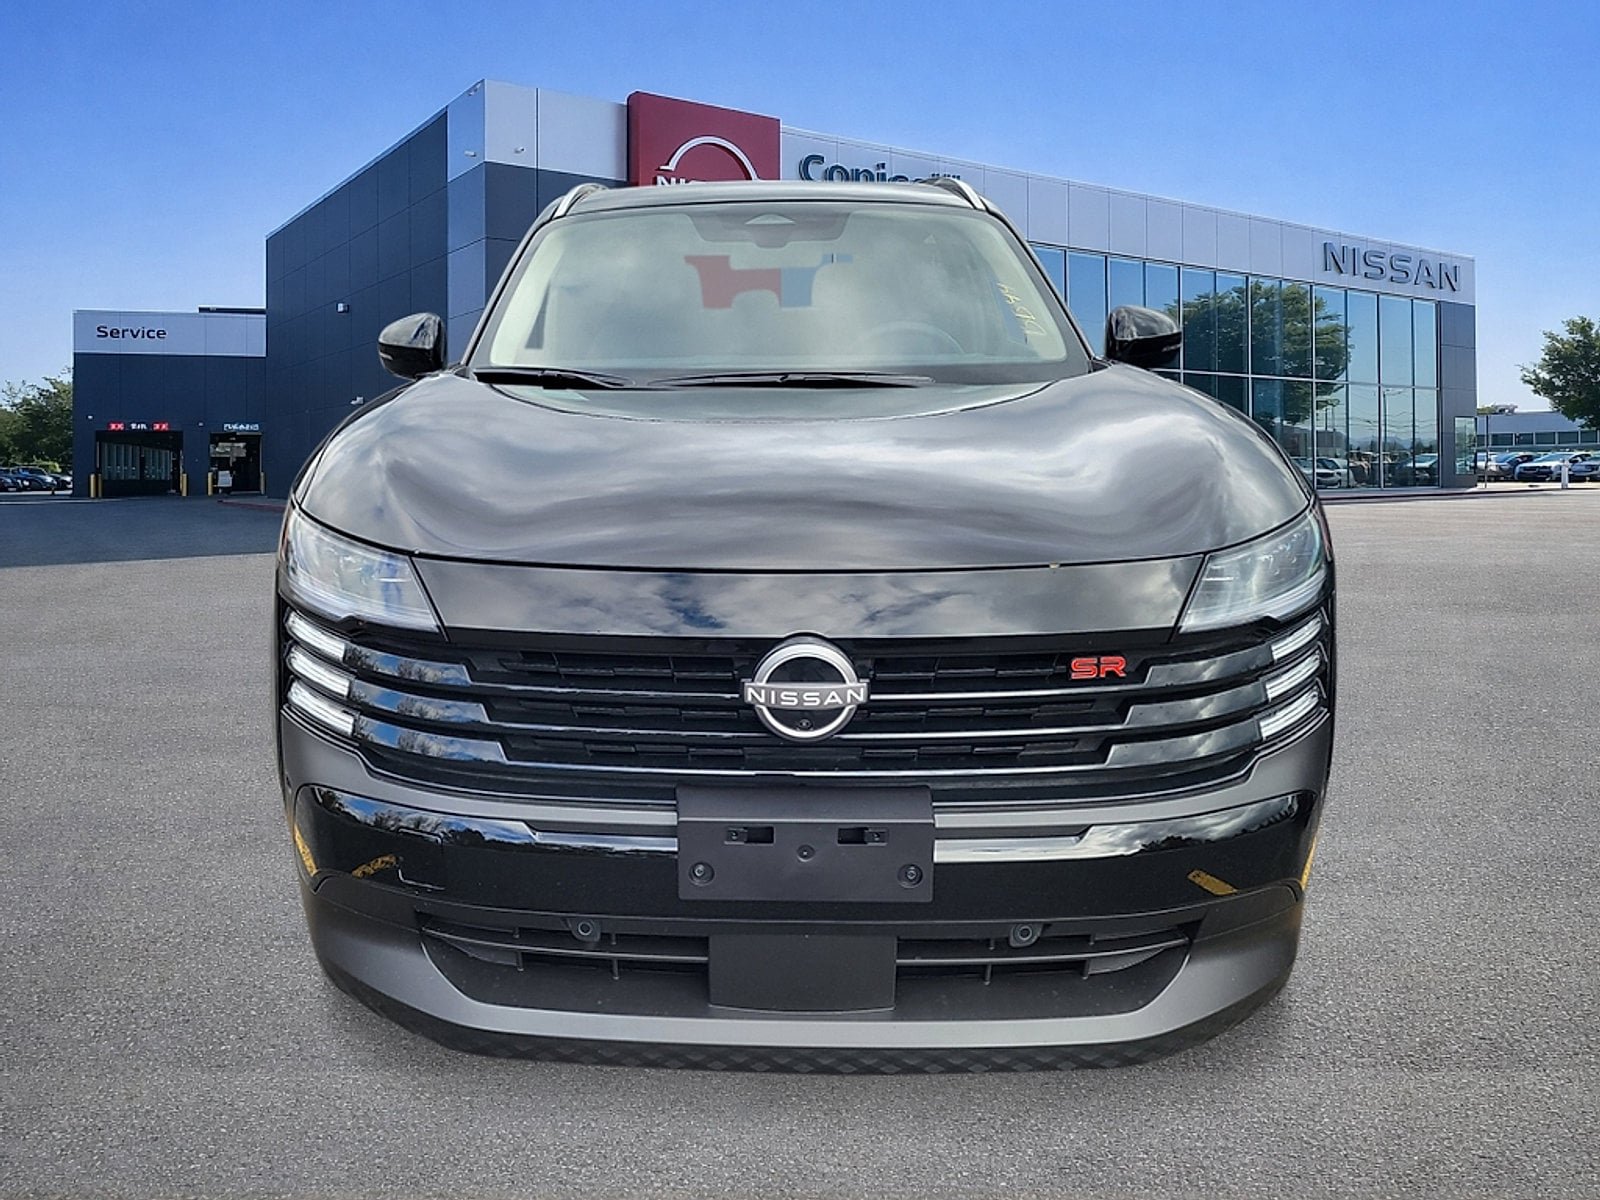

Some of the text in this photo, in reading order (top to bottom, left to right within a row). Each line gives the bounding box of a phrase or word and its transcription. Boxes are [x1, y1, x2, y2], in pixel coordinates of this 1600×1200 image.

[1323, 241, 1461, 292] NISSAN
[96, 325, 167, 339] Service
[1071, 656, 1127, 679] SR
[747, 687, 864, 706] NISSAN
